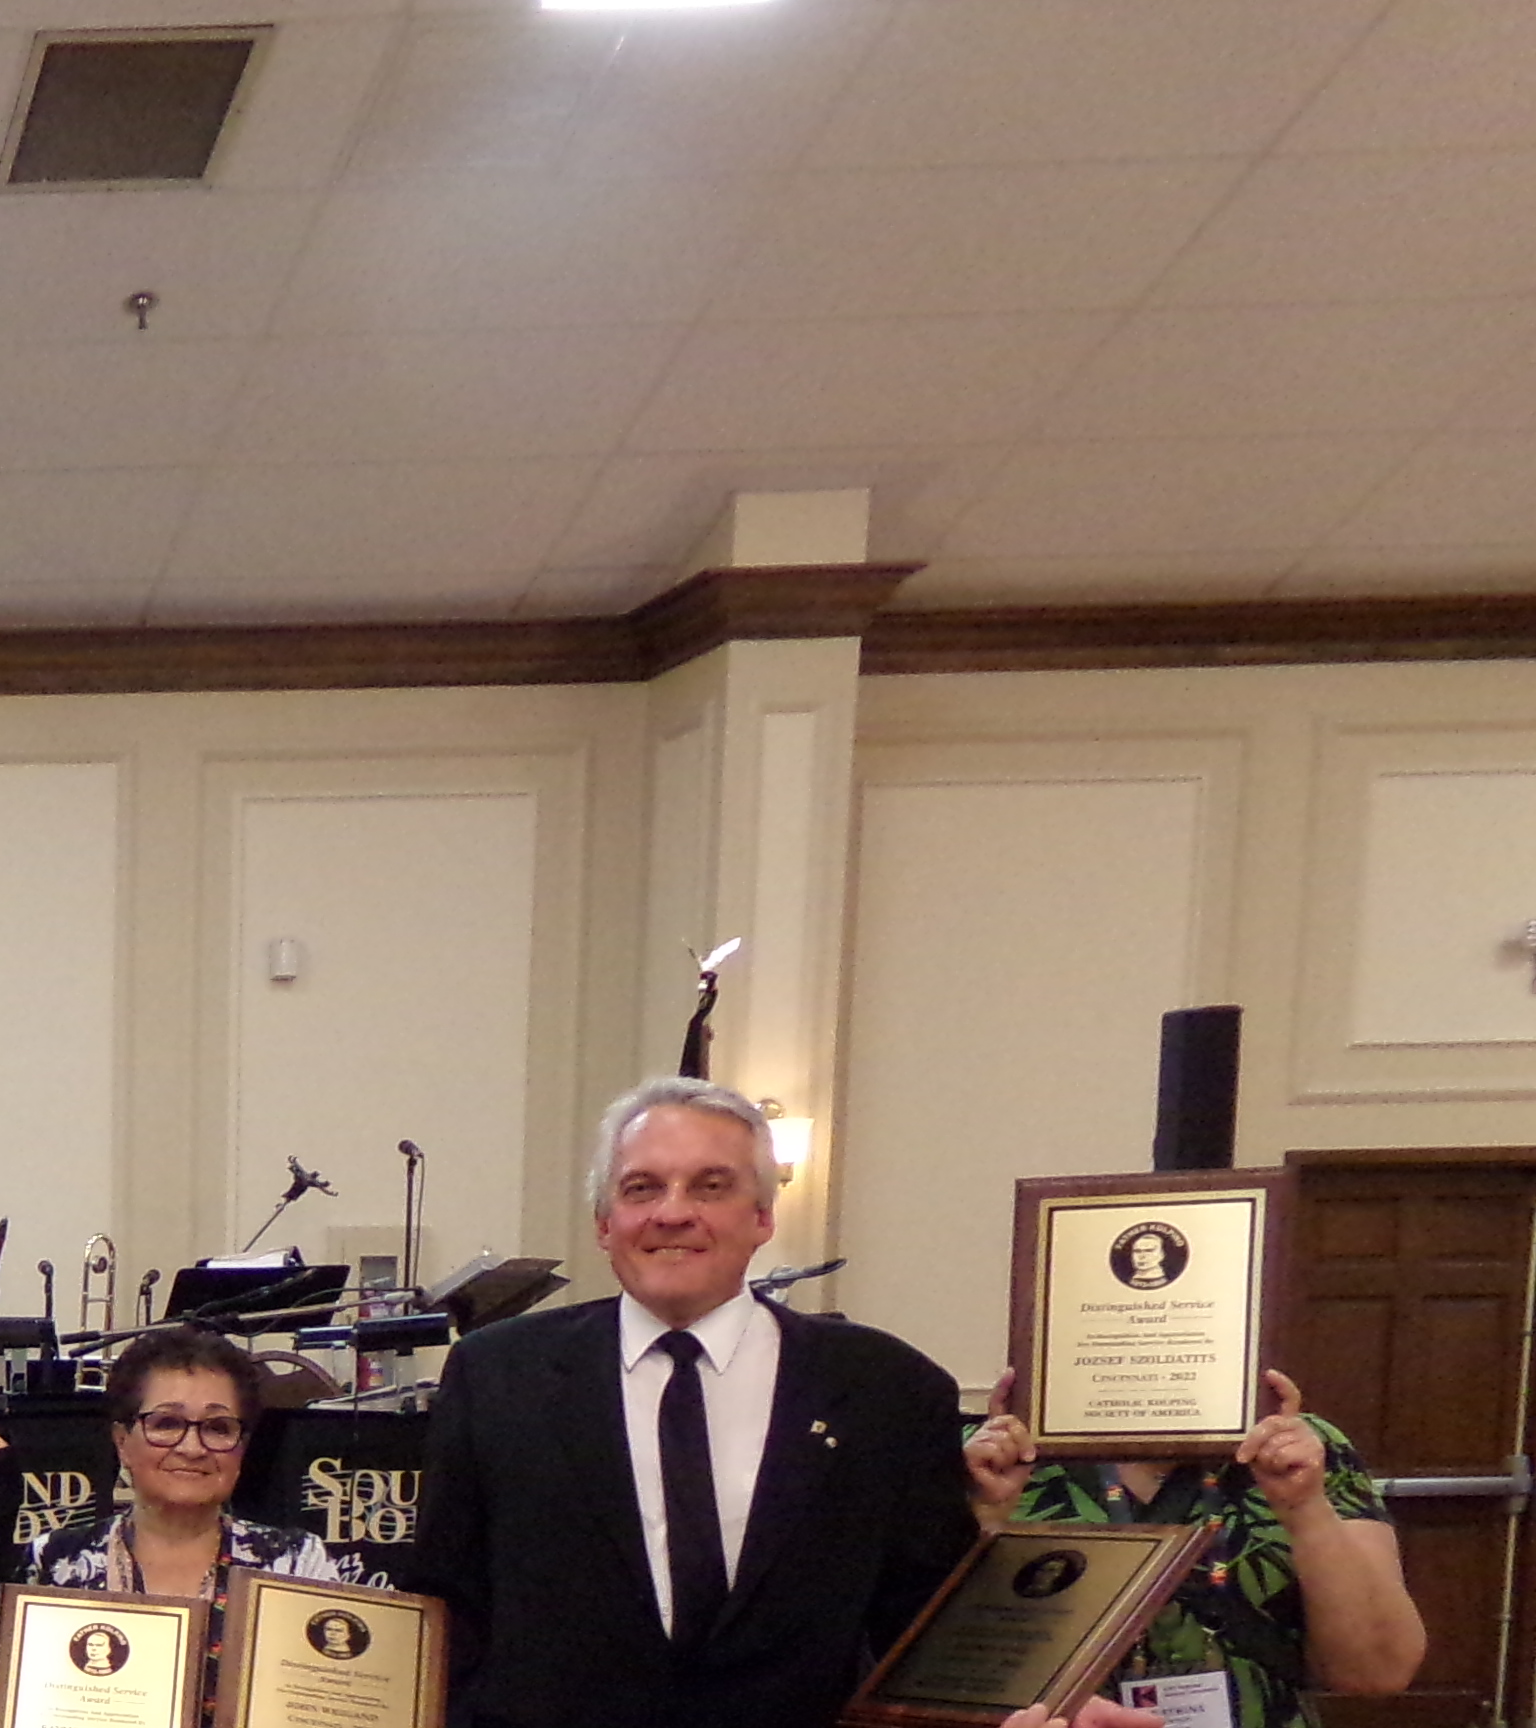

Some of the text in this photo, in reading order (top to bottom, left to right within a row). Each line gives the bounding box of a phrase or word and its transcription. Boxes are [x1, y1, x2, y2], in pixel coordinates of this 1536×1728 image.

[1081, 1301, 1166, 1312] Distinguished
[1127, 1315, 1167, 1323] Award
[45, 1682, 111, 1694] Distinguished
[79, 1695, 111, 1704] Award
